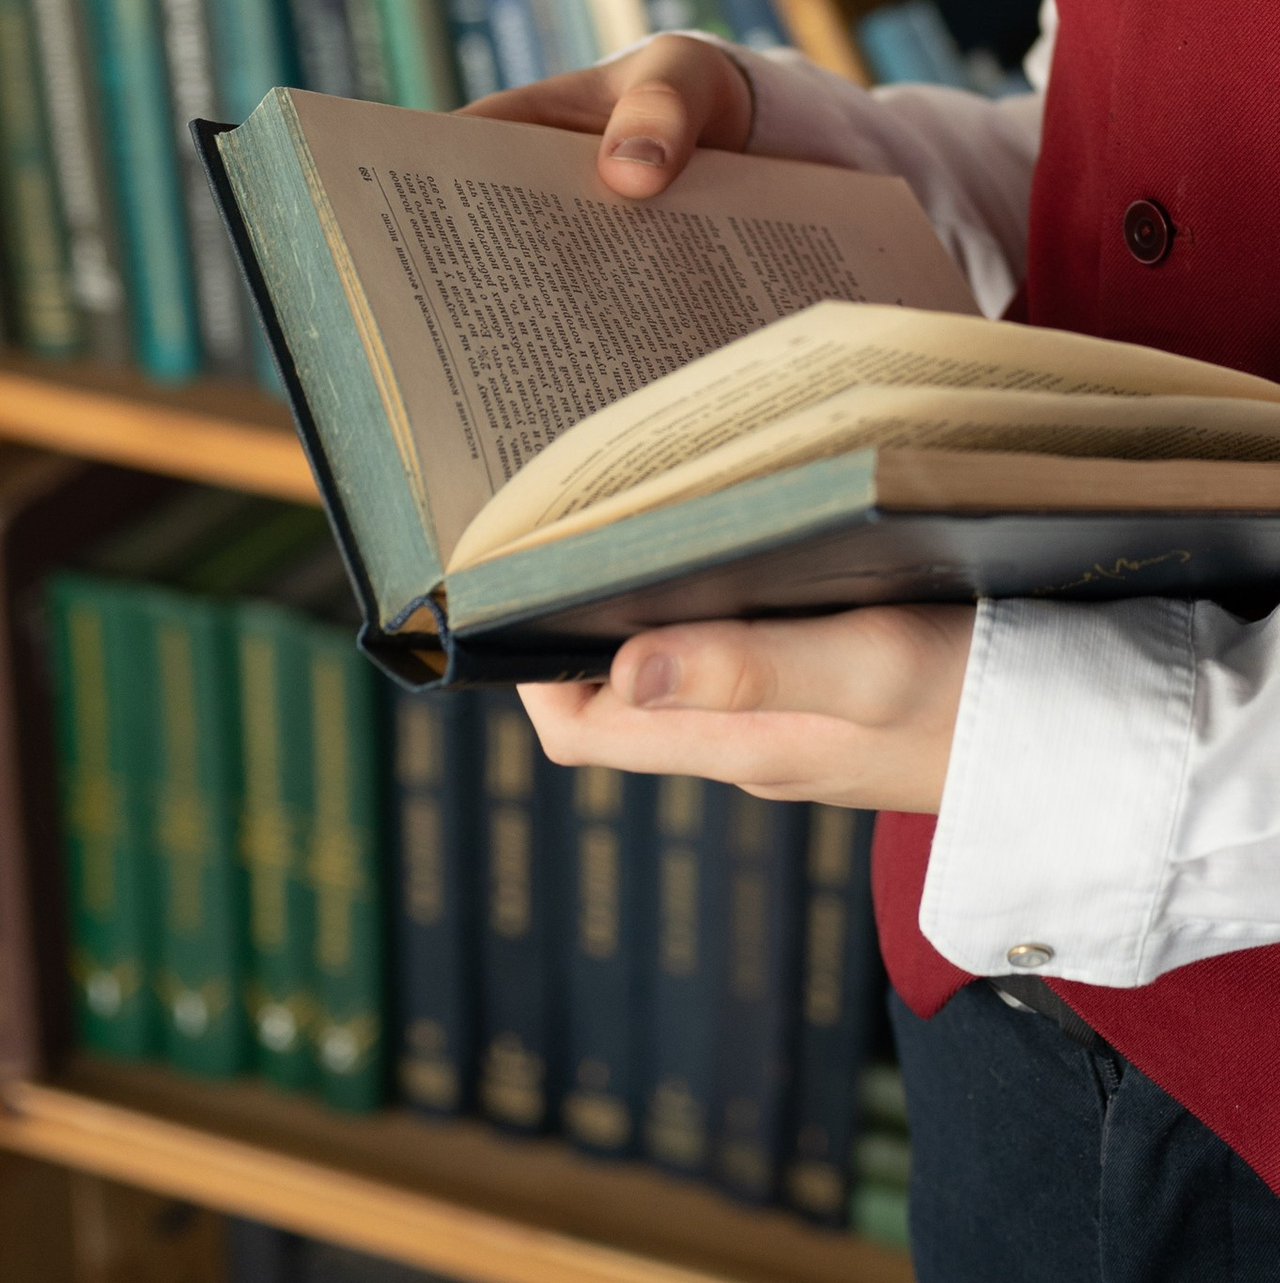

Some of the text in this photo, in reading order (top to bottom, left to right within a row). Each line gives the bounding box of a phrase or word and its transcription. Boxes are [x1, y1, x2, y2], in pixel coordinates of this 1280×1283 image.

[357, 166, 372, 181] 189
[388, 169, 415, 214] долевое
[402, 172, 417, 194] нет,
[426, 175, 439, 194] это
[414, 200, 435, 239] ничего
[435, 197, 446, 210] то
[477, 181, 517, 249] разногласия
[500, 184, 522, 215] своей
[512, 186, 550, 251] обсуждений
[528, 188, 545, 216] Мар-
[536, 190, 551, 208] бо-
[548, 212, 560, 225] не
[549, 193, 564, 212] нас
[560, 214, 571, 228] на
[543, 221, 551, 230] т.
[567, 230, 582, 250] они
[585, 199, 635, 287] меньшевистскую
[596, 201, 624, 245] обвинял
[395, 246, 418, 289] ФРАКЦИИ
[409, 218, 438, 274] известное
[432, 245, 446, 264] нас
[444, 215, 483, 289] крестьянами,
[467, 237, 497, 287] рабочим.
[524, 230, 547, 266] нужно
[550, 235, 582, 294] Например,
[578, 253, 591, 267] ли
[512, 256, 532, 288] такие
[543, 271, 559, 292] нам
[564, 242, 599, 306] чистоганом,
[573, 197, 657, 353] свою брошюру, написанную
[586, 268, 607, 301] будут
[611, 204, 694, 359] что она идет на концессию,
[632, 206, 712, 348] меньшевиков упрекать нас
[647, 254, 690, 328] буржуазными
[678, 271, 703, 310] Европе
[415, 173, 532, 452] это уже кое-что. Если мы от миллиона полу-
[435, 279, 462, 328] получим
[450, 285, 470, 316] когда
[453, 178, 564, 429] хотел указать на то, что некоторые заме-
[465, 179, 571, 412] вы сделали нам, все же показывают, что
[489, 182, 596, 412] ать, недоумения, которые представляют
[531, 294, 546, 319] есть
[550, 261, 590, 330] дальнейших
[571, 213, 658, 380] счет мы должны сговориться.
[637, 280, 673, 338] меньшевик
[702, 279, 738, 335] Брестский
[458, 334, 471, 351] мы
[467, 322, 479, 337] но
[484, 304, 504, 338] обмен
[491, 291, 529, 368] необходимых
[543, 325, 563, 358] среде
[556, 297, 582, 344] которые
[583, 300, 616, 361] устранить.
[598, 311, 624, 355] платить
[633, 293, 668, 350] цитировал
[413, 294, 458, 395] КОММУНИСТИЧЕСКОЙ
[467, 356, 480, 377] что
[505, 355, 519, 375] это
[587, 340, 607, 375] путем
[476, 383, 498, 428] потому
[487, 377, 512, 429] кажется
[514, 380, 536, 424] пустим
